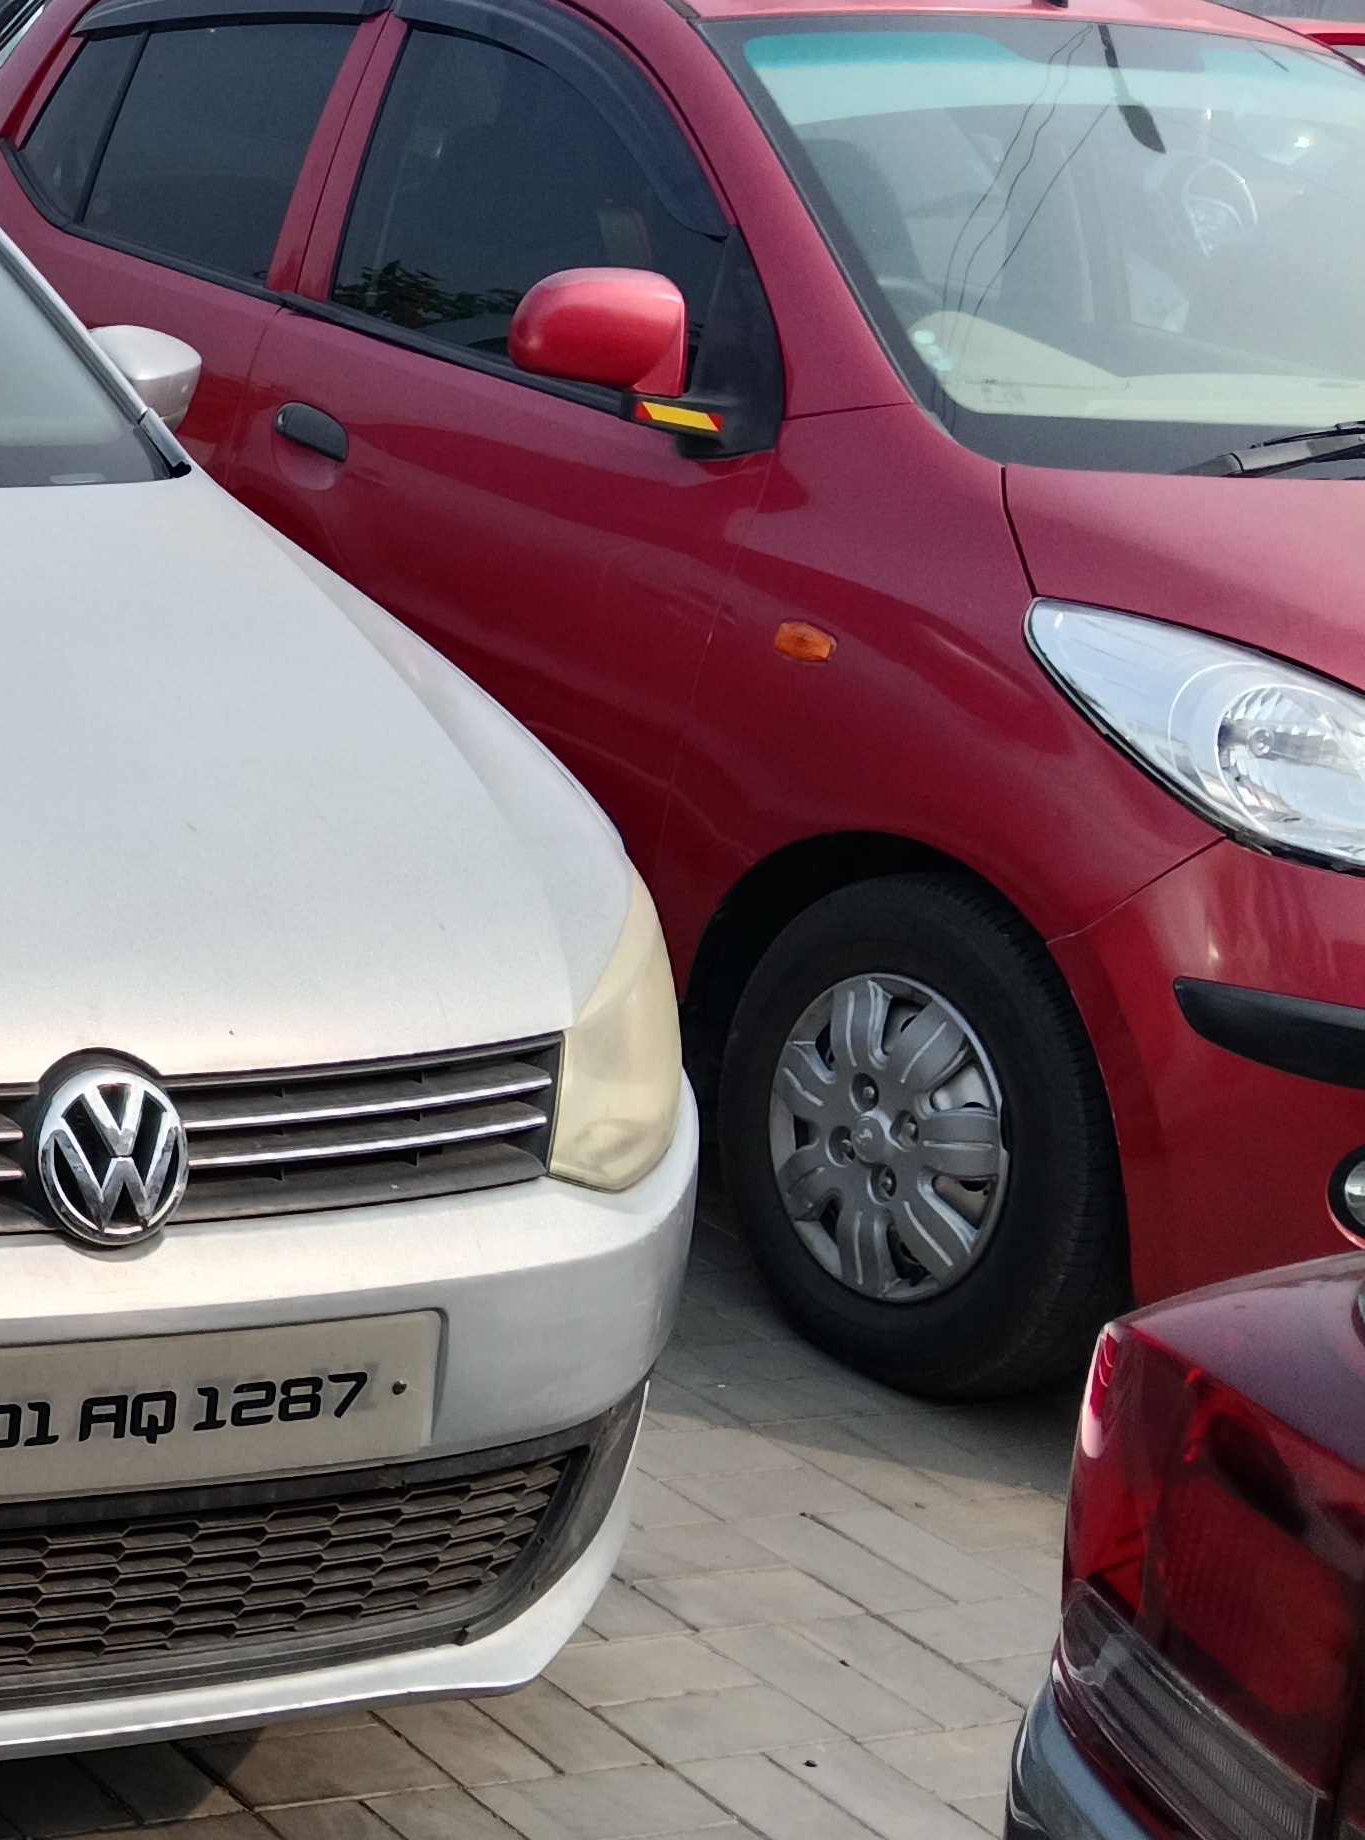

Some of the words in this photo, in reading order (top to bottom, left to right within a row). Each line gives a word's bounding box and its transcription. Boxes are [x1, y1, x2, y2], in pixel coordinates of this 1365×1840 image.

[41, 1076, 183, 1240] VW
[78, 1390, 177, 1445] AQ
[192, 1370, 368, 1432] 1287
